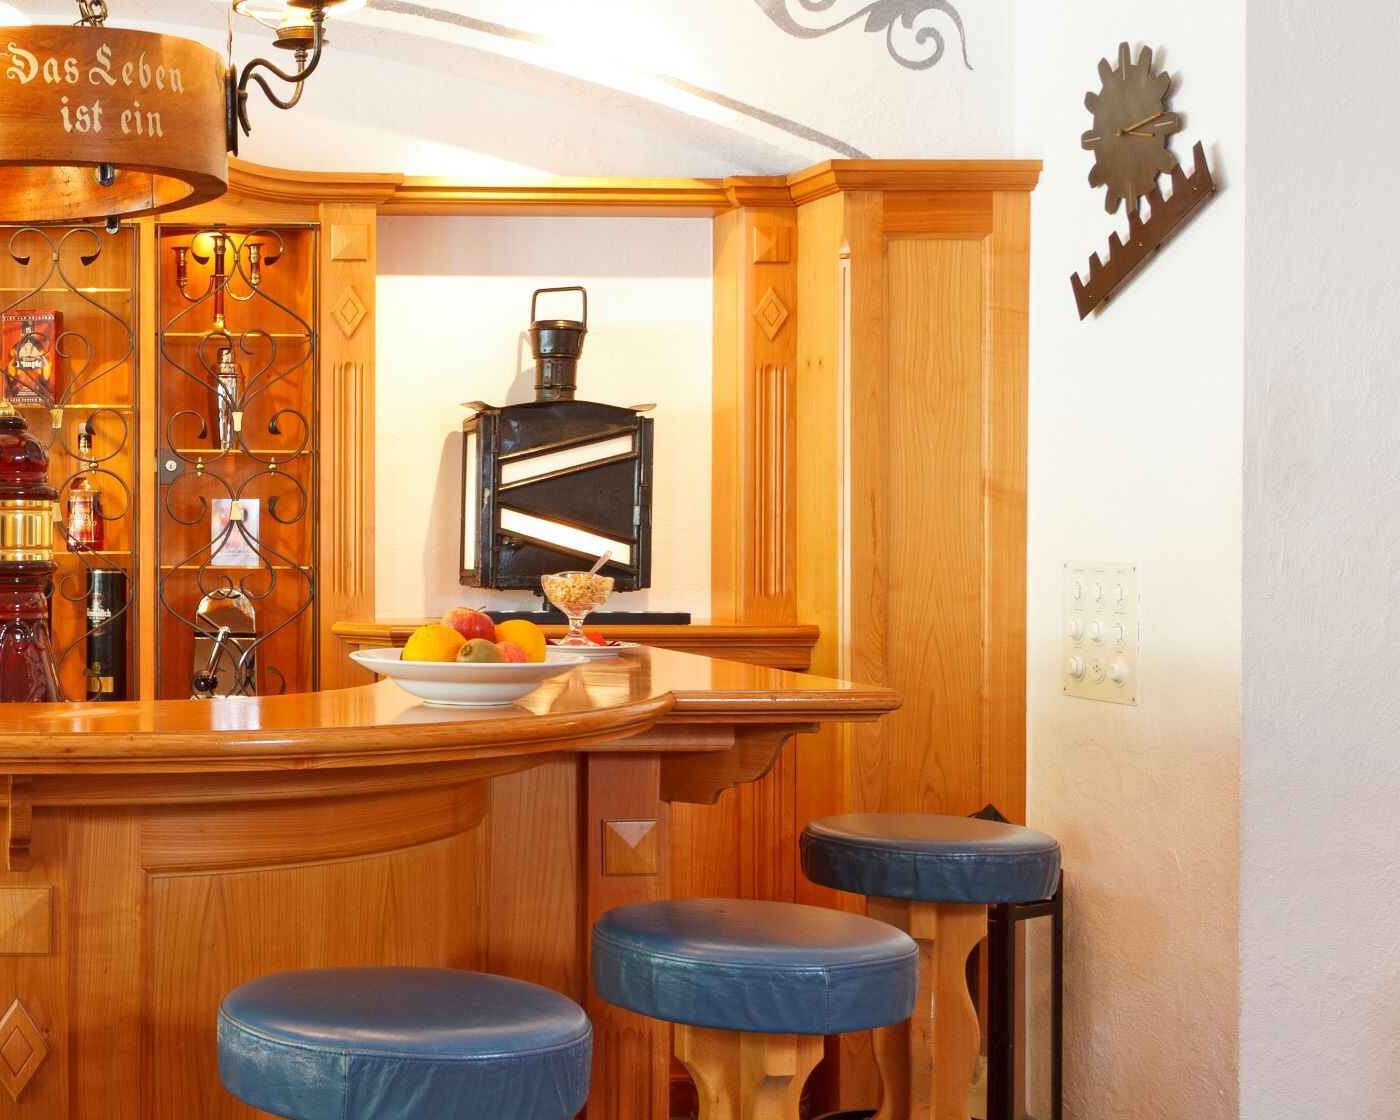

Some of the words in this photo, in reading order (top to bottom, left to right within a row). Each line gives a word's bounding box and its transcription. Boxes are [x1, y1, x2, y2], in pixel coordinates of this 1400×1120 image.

[89, 43, 186, 94] Leben
[60, 96, 103, 134] ist
[120, 101, 164, 138] ein
